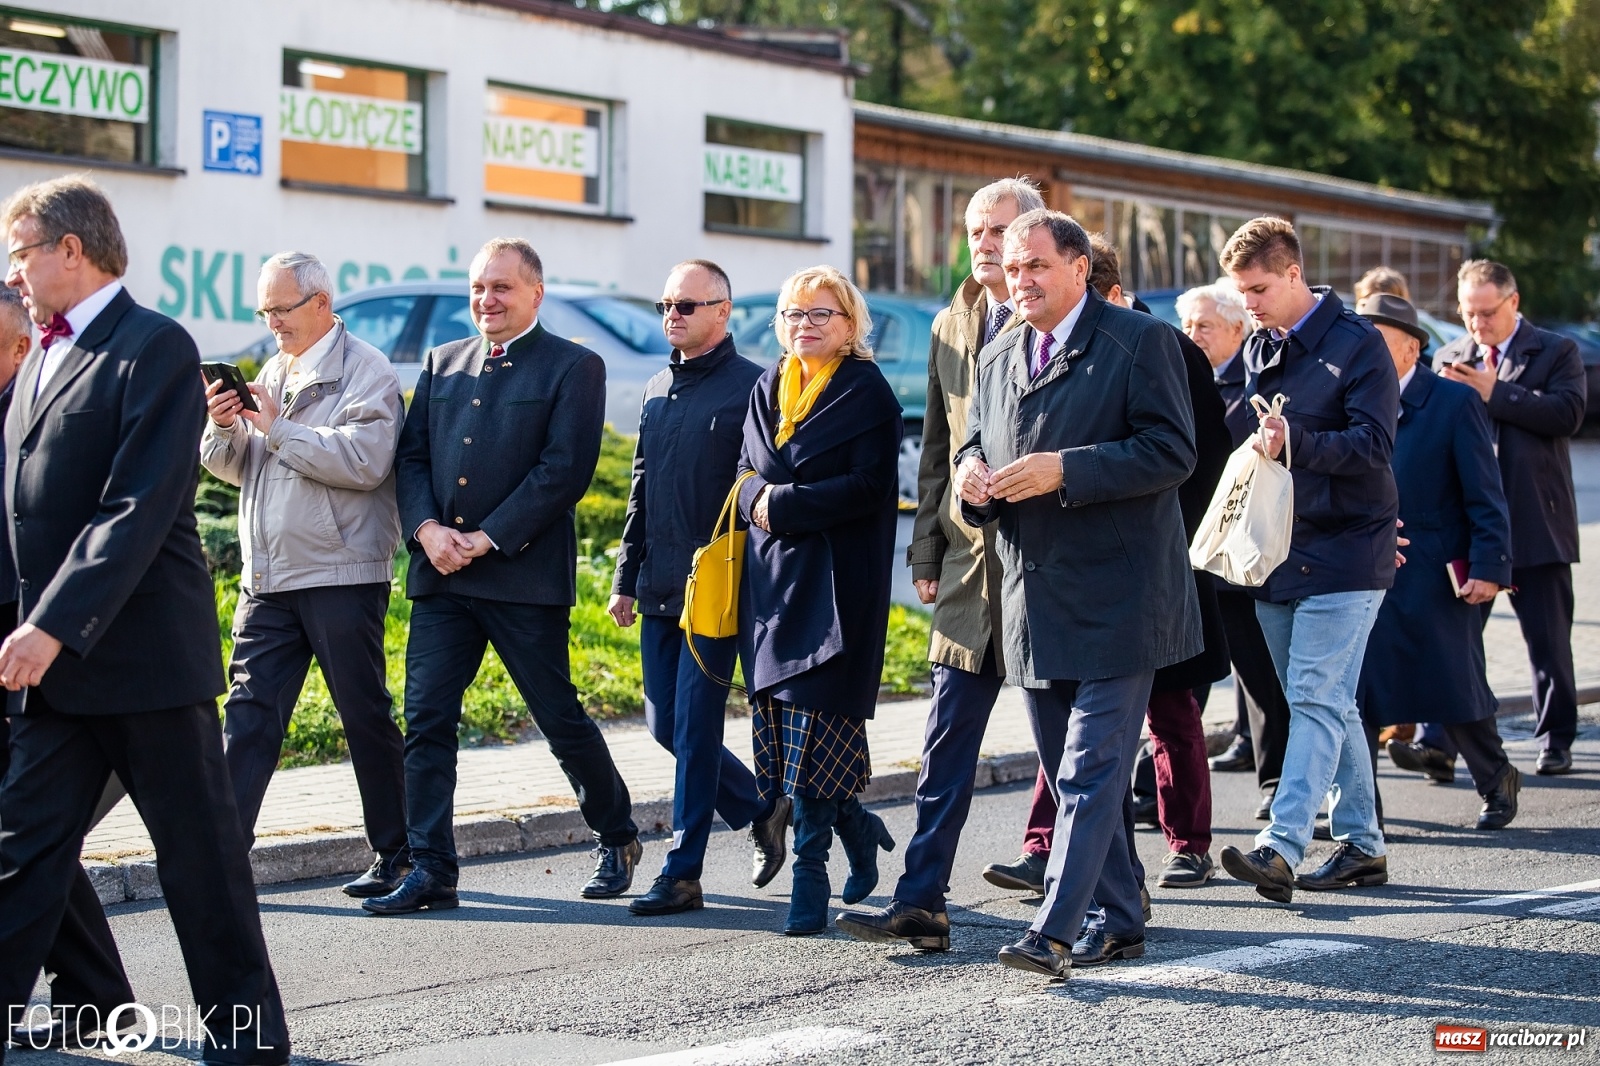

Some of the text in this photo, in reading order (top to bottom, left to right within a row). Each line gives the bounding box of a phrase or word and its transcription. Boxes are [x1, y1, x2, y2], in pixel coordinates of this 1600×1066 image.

[210, 120, 231, 163] P
[482, 121, 585, 169] NAPOJE
[704, 150, 788, 195] NABIAŁ
